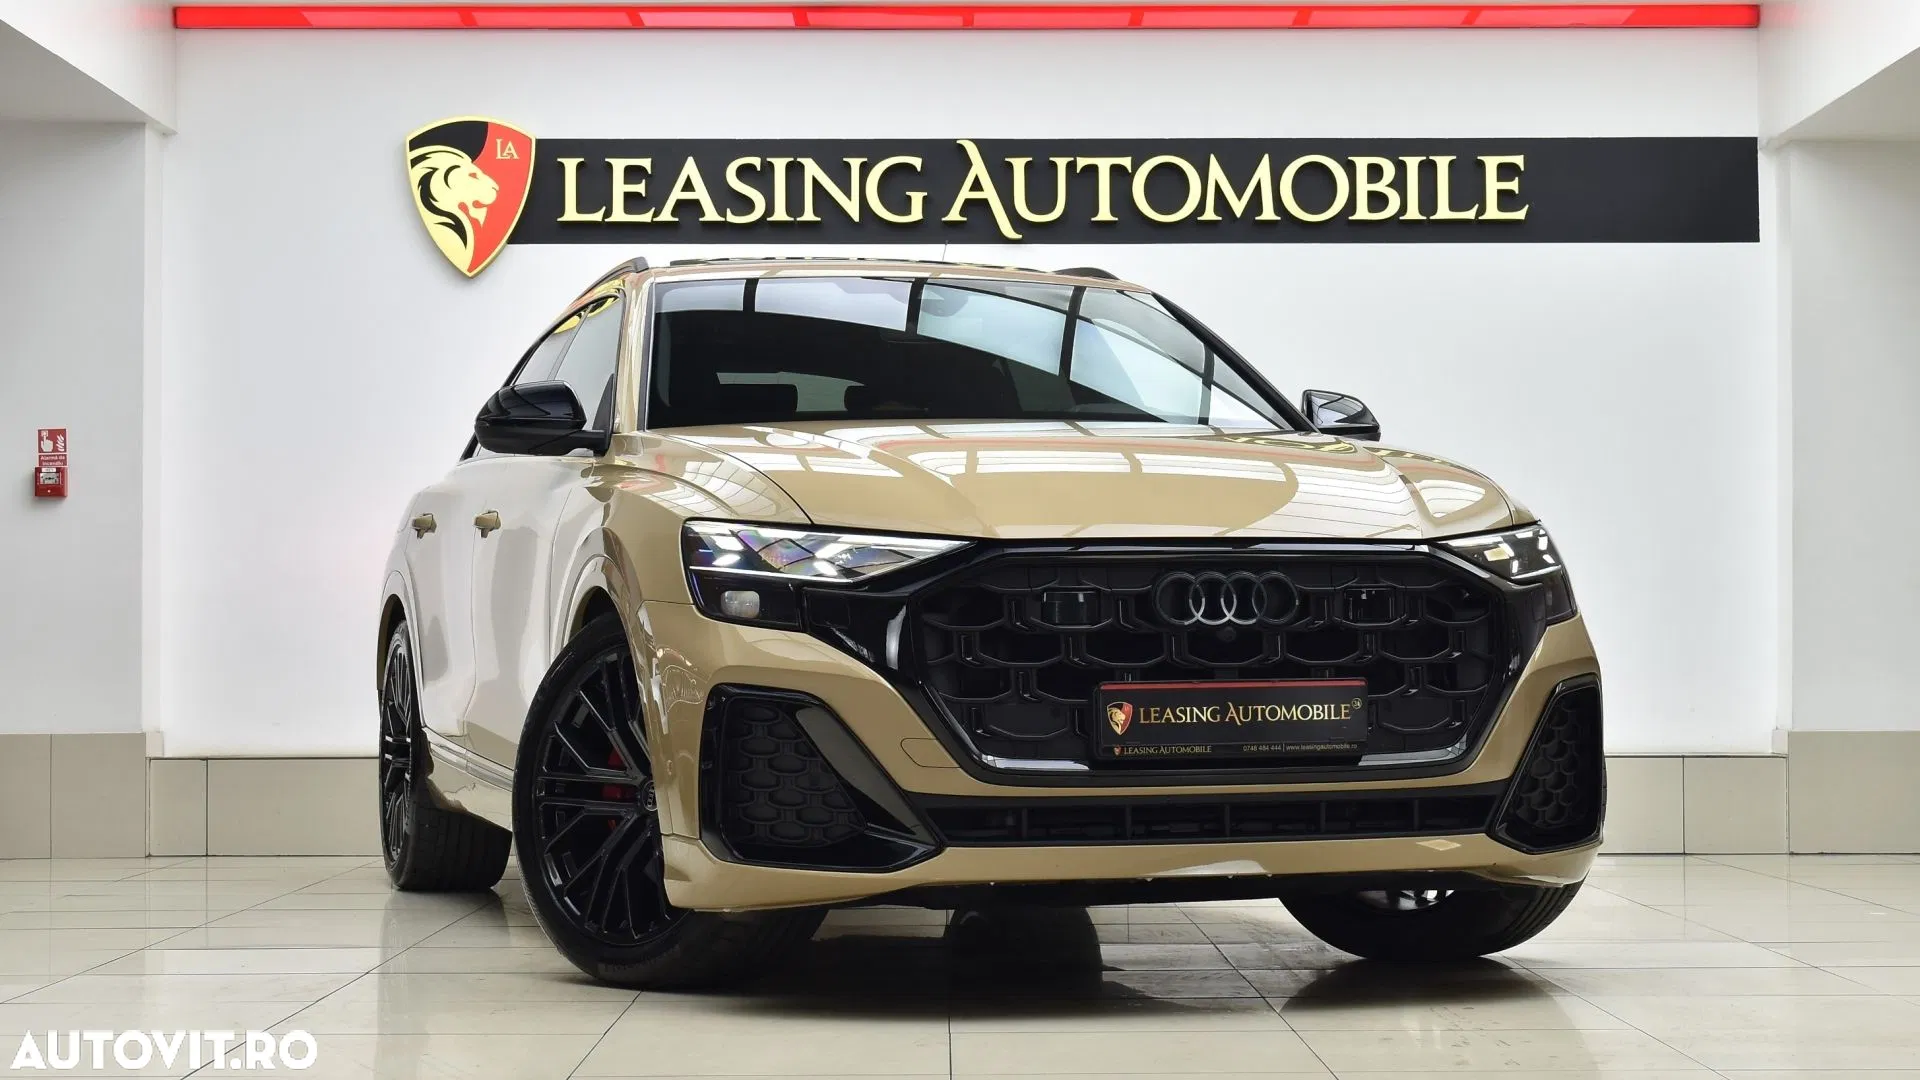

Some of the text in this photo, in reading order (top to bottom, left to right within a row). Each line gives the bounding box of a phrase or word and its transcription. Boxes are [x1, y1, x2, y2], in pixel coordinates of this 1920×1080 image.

[495, 138, 520, 160] LA
[556, 139, 1530, 240] LEASING AUTOMOBILE
[1139, 706, 1221, 724] LEASING
[1225, 702, 1351, 726] AUTOMOBILE
[1124, 745, 1212, 755] LEASING AUTOMOBILE
